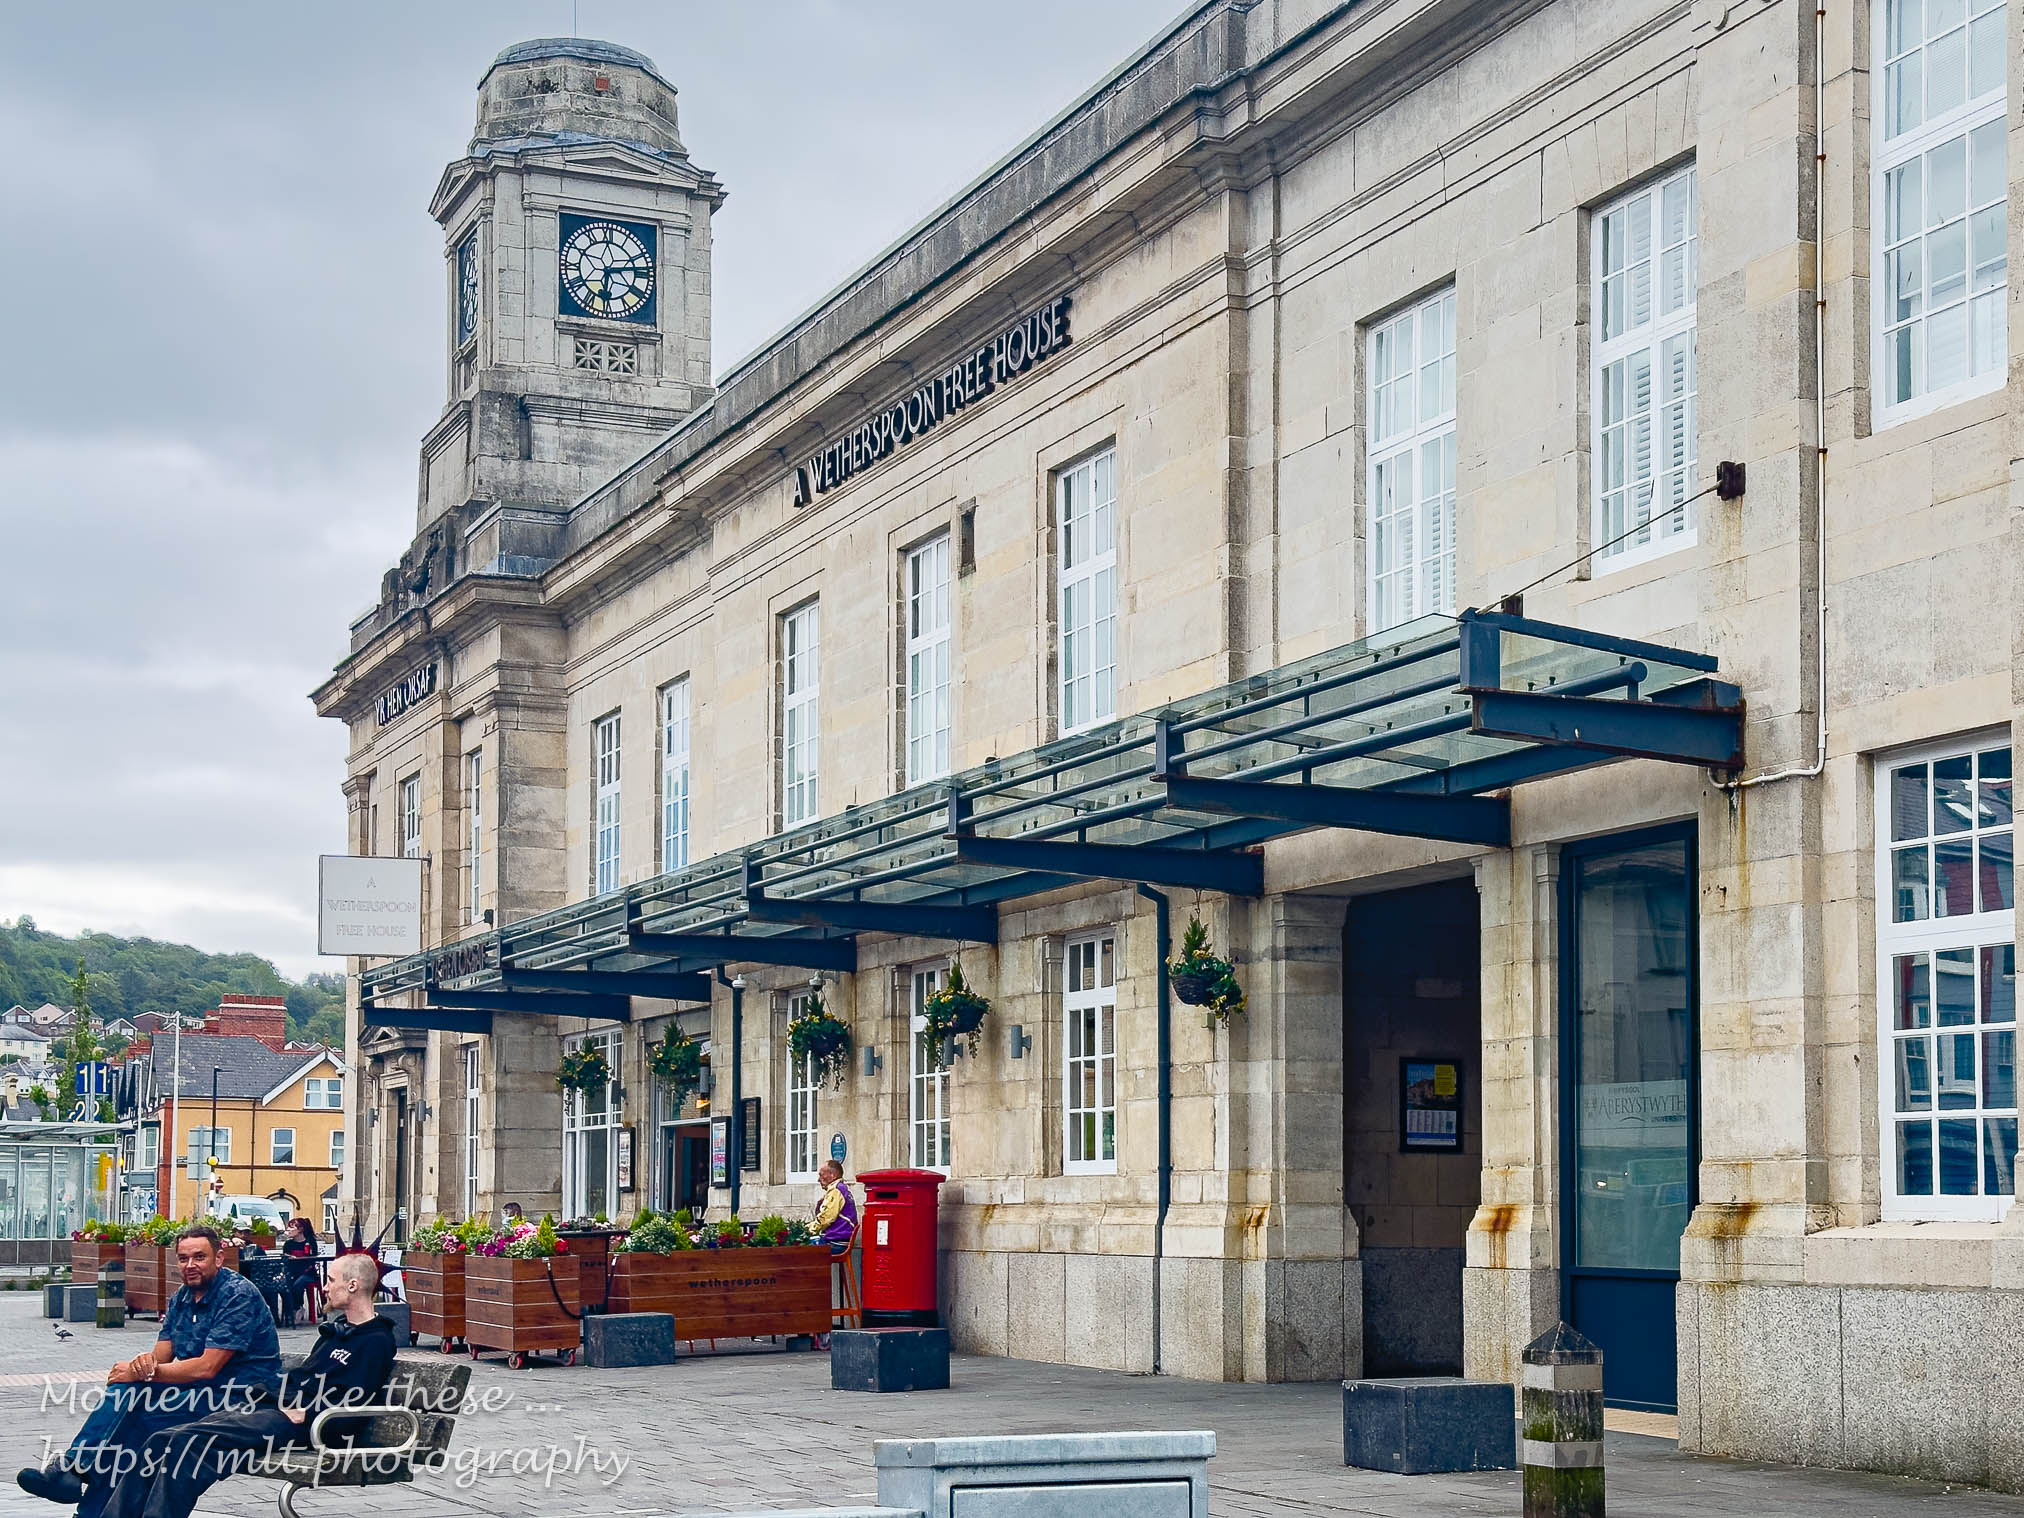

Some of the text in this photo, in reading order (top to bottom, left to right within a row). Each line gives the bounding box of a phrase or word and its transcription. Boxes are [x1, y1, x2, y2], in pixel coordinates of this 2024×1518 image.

[793, 296, 1073, 508] A WETHERSPOON FREE HOUSE
[375, 663, 436, 727] YR HEN ORSAF
[366, 876, 377, 889] A
[327, 899, 417, 913] WETHERSPOON
[336, 924, 407, 938] FREE HOUSE
[79, 1065, 88, 1093] 1
[98, 1065, 107, 1093] 1
[1599, 1095, 1686, 1120] ABERYSTWYTH
[688, 1277, 777, 1290] wetherspoon
